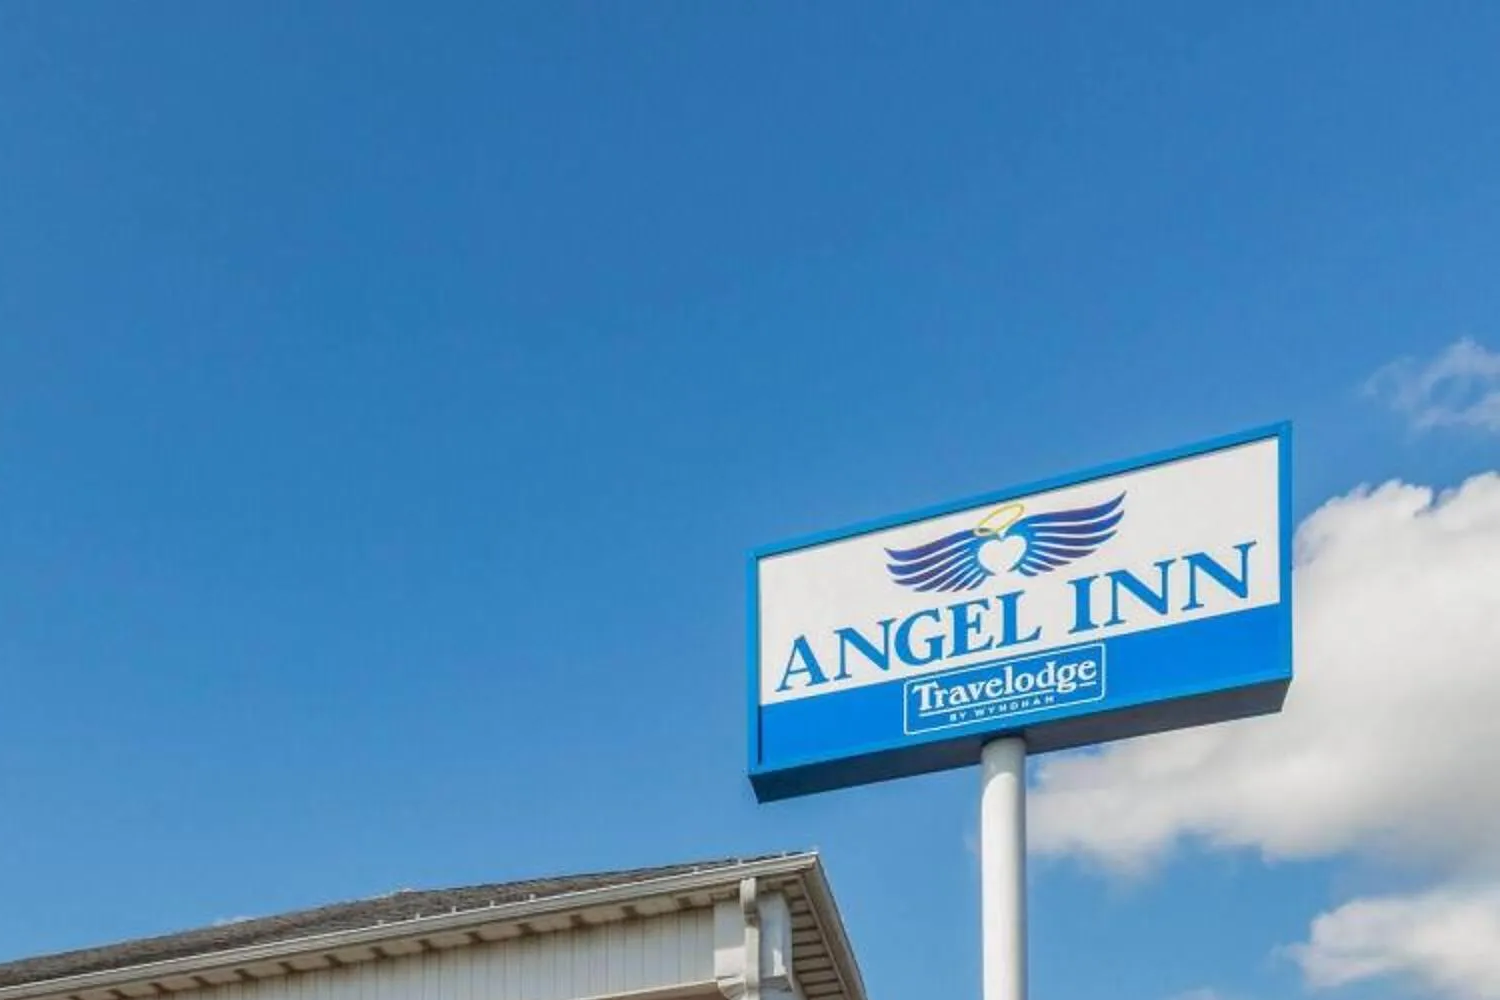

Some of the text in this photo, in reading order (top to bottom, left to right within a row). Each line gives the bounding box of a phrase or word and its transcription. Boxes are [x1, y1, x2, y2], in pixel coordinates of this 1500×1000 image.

[775, 540, 1258, 692] ANGEL INN
[912, 659, 1097, 711] Travelodge
[949, 695, 1056, 722] BY WYNDHAM
